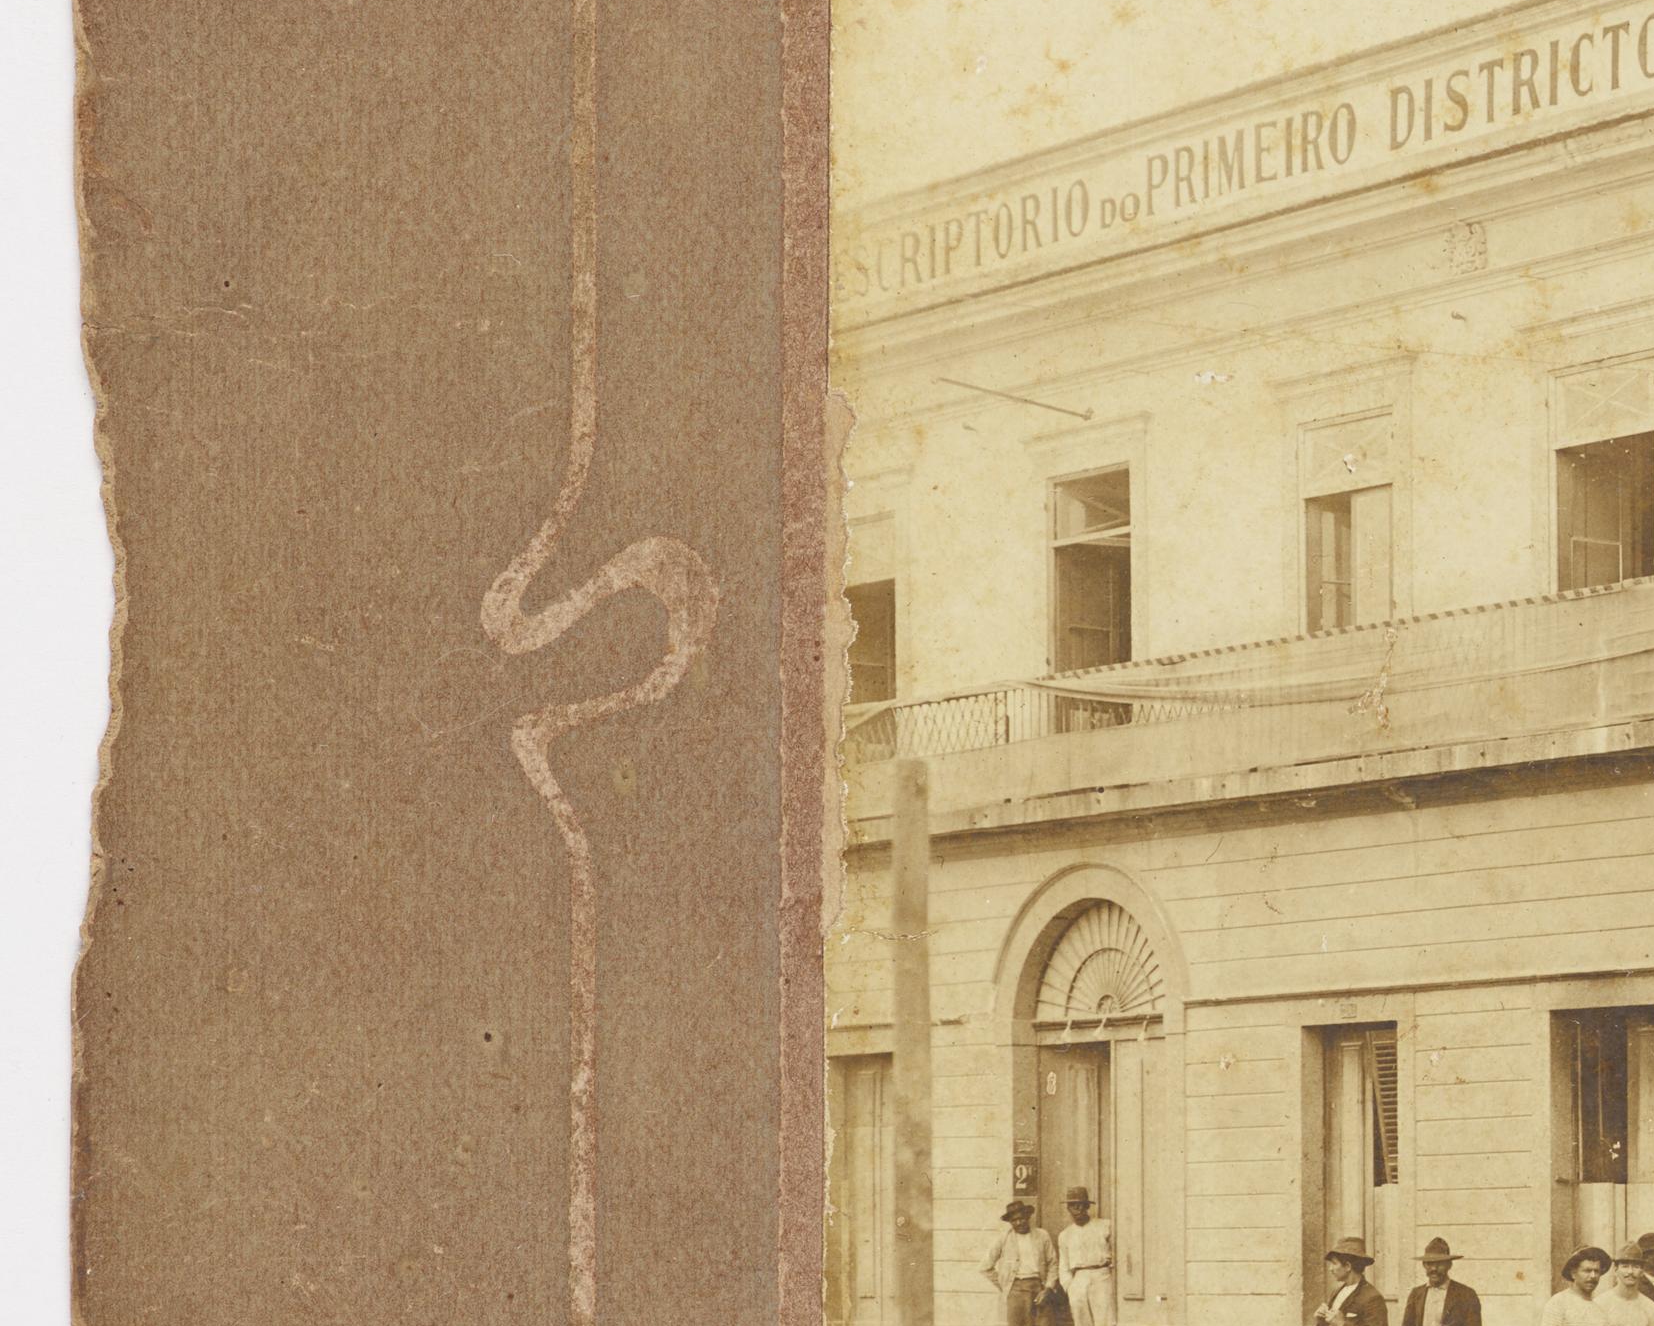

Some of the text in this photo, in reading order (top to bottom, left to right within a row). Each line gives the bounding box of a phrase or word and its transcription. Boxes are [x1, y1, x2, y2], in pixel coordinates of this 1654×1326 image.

[836, 178, 1090, 299] SCRIPTORIO
[1100, 191, 1142, 231] DO
[1145, 102, 1358, 218] PRIMEIRO
